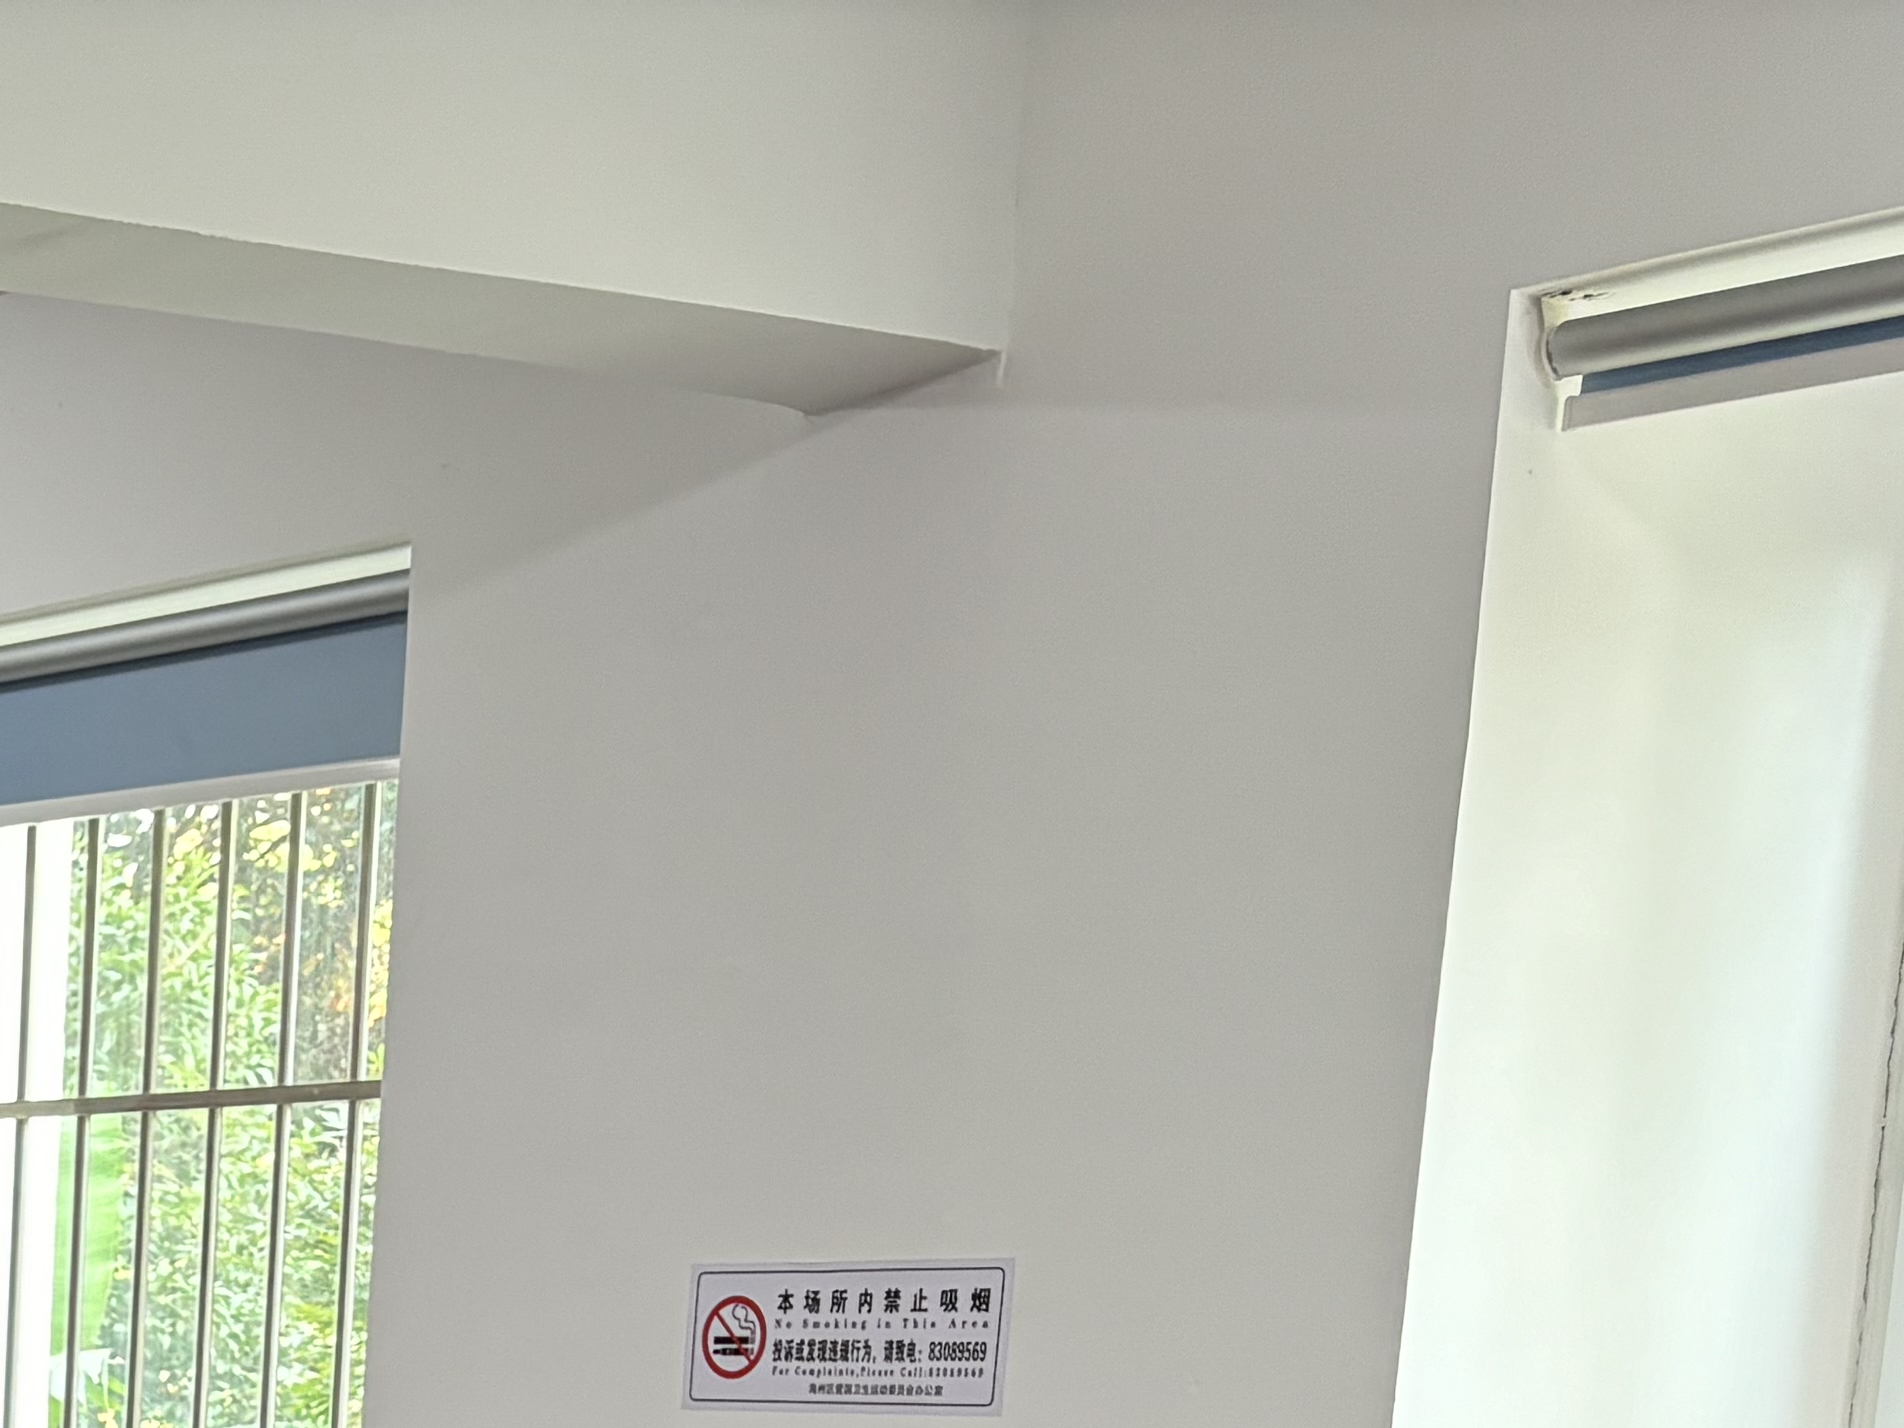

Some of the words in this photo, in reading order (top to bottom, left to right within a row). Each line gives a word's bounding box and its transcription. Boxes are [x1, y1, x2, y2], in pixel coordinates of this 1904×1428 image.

[776, 1287, 991, 1314] 本场所内禁止吸烟
[775, 1318, 793, 1330] No
[802, 1318, 867, 1331] Smoking
[902, 1317, 937, 1330] This
[948, 1317, 989, 1330] Area
[772, 1365, 790, 1377] For
